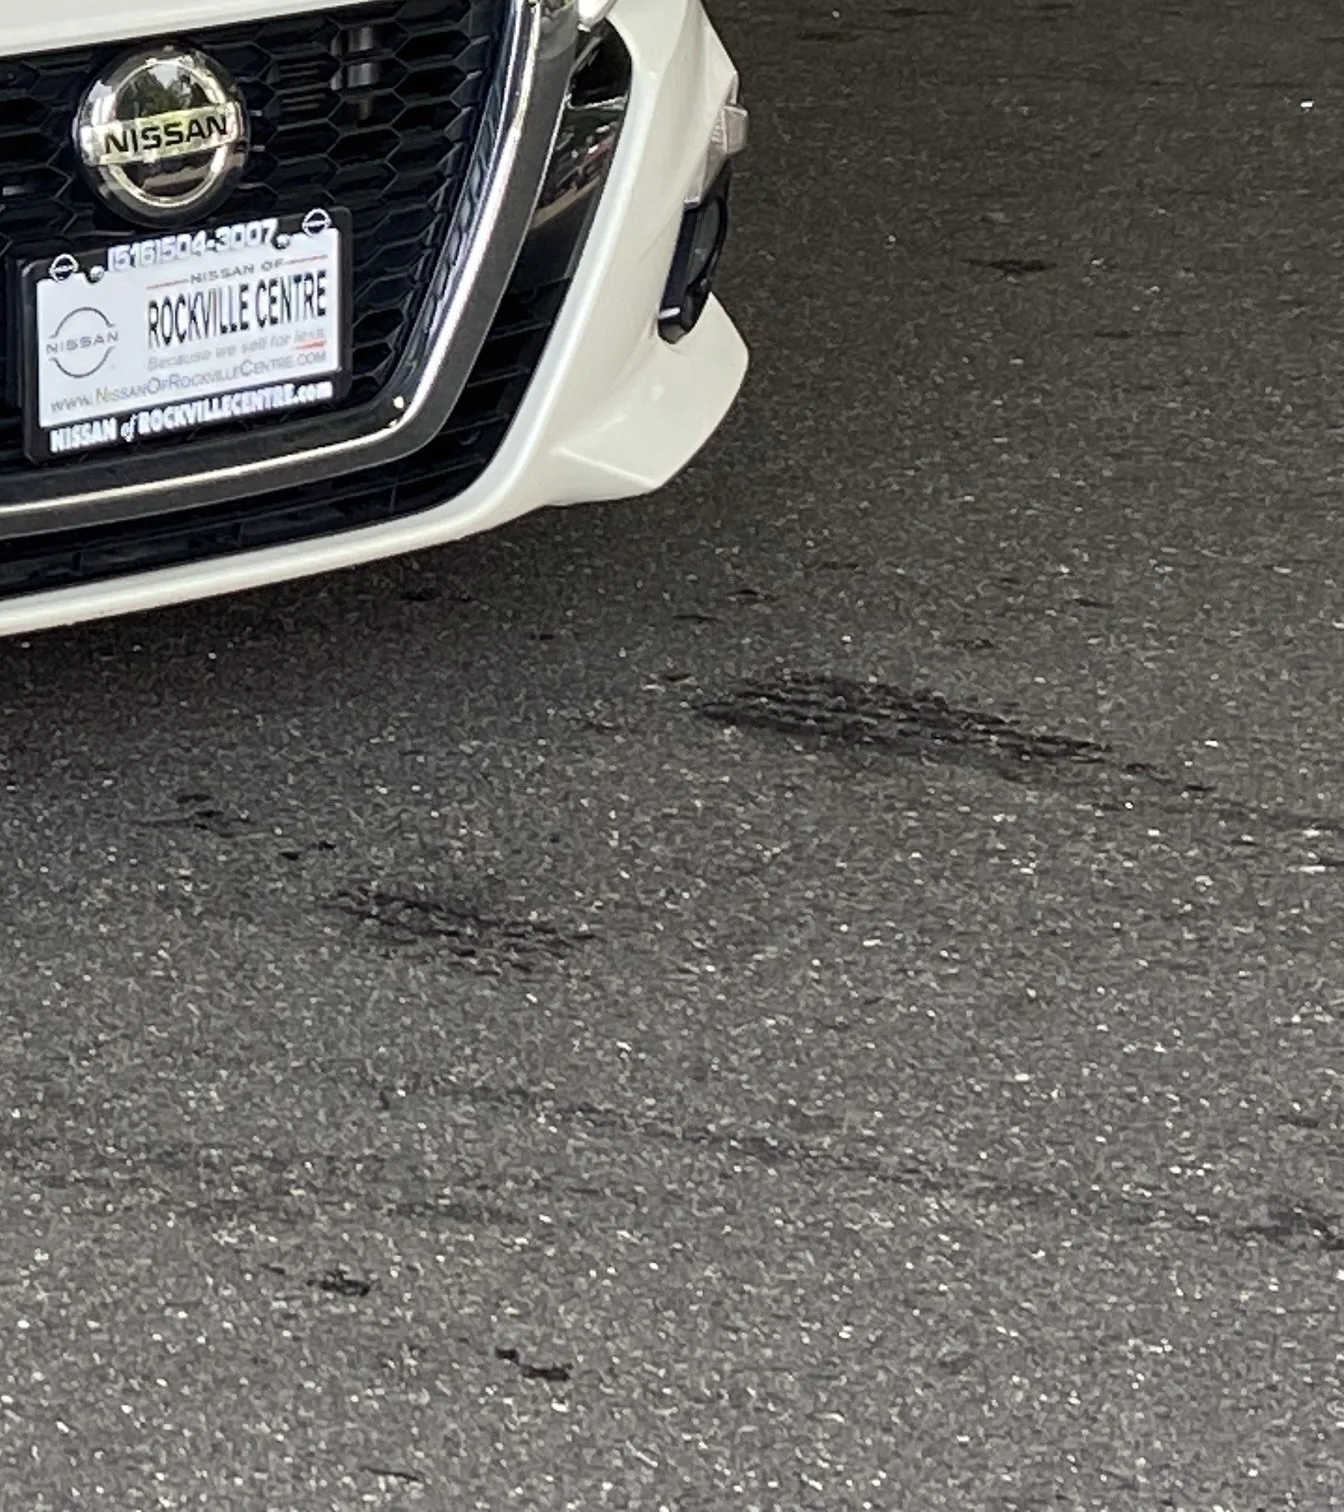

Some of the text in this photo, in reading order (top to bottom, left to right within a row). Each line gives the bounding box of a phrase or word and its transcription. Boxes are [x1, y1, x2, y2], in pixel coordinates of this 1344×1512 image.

[103, 114, 227, 154] NISSAN
[190, 258, 286, 284] NISSAN OF
[147, 268, 328, 350] ROCKVILLE CENTRE
[45, 331, 119, 355] NISSAN
[50, 417, 117, 453] NISSAN
